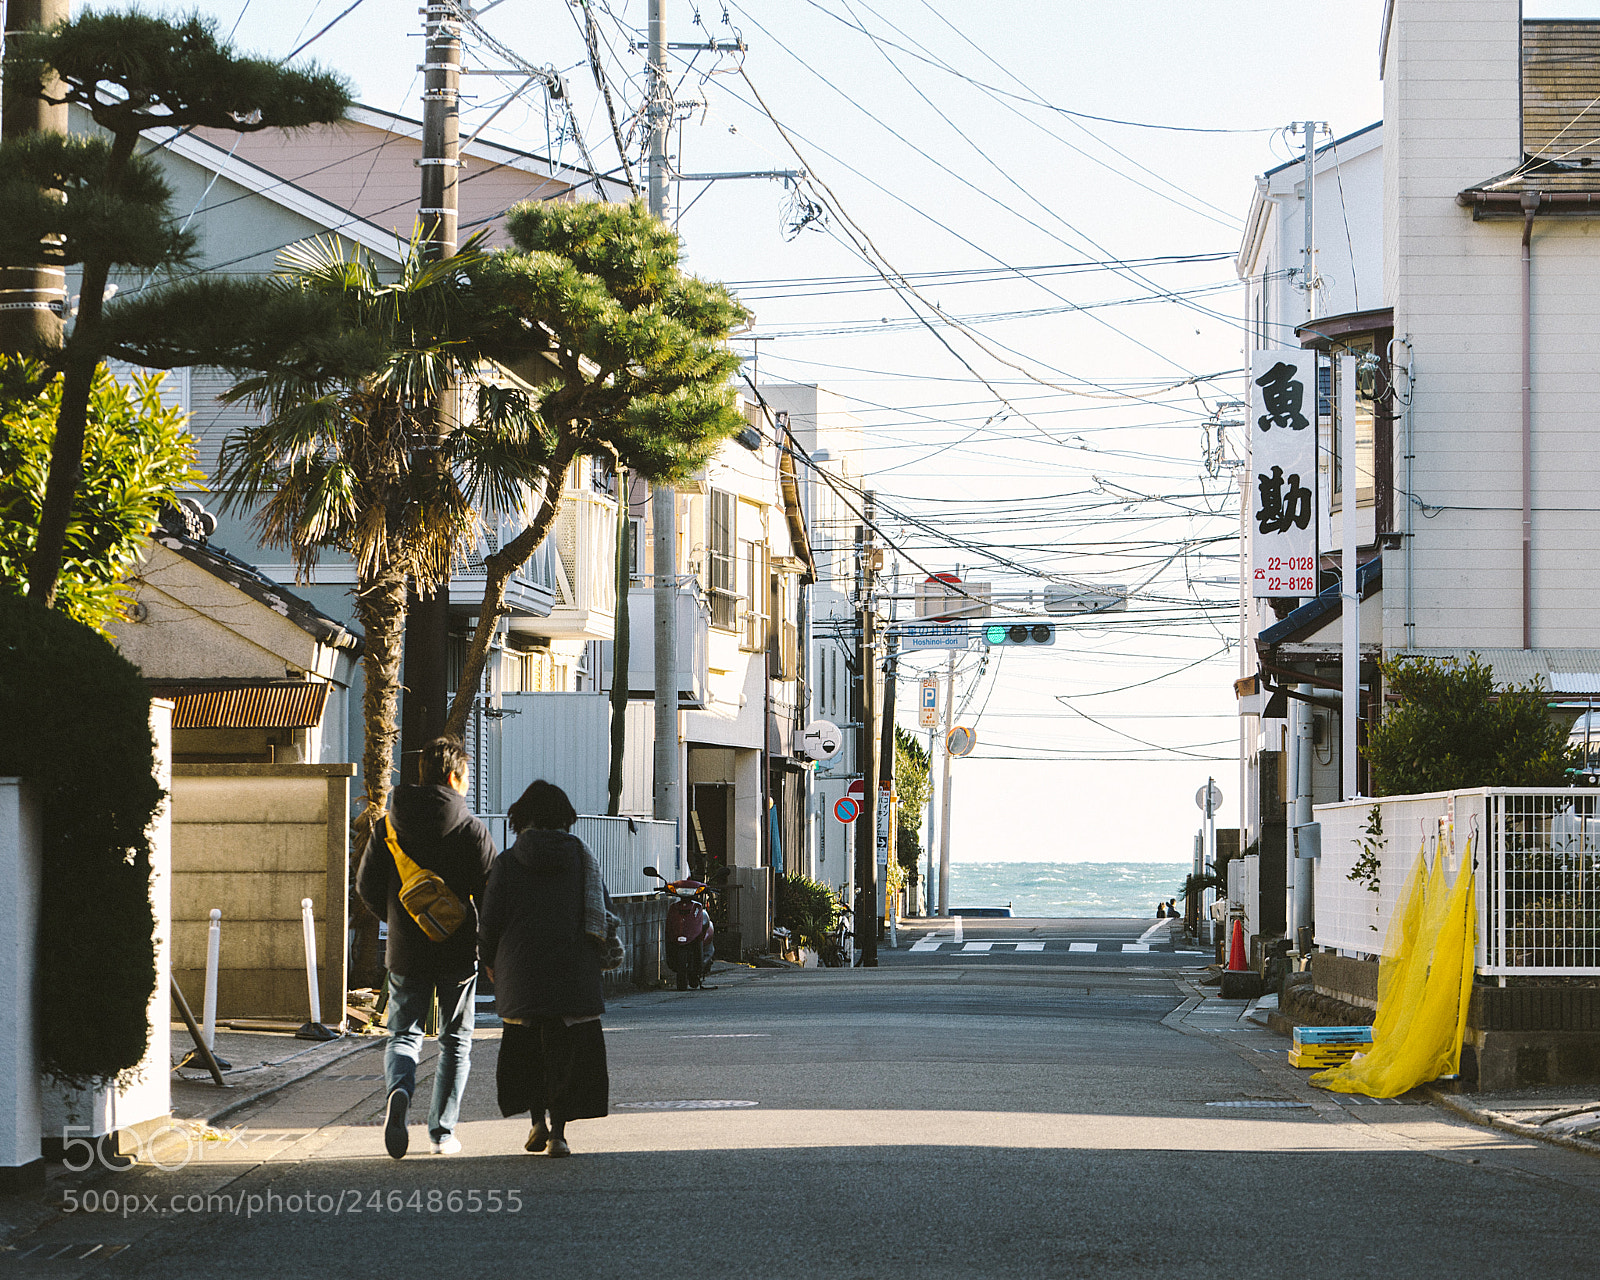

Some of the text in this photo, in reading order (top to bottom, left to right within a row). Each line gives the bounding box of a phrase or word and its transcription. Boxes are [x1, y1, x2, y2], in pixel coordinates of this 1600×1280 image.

[1255, 361, 1312, 535] 魚勘
[1268, 557, 1314, 571] 22-0128
[1268, 577, 1314, 591] 22-8126
[912, 637, 958, 647] Hoshinoi-dori
[924, 689, 935, 706] P
